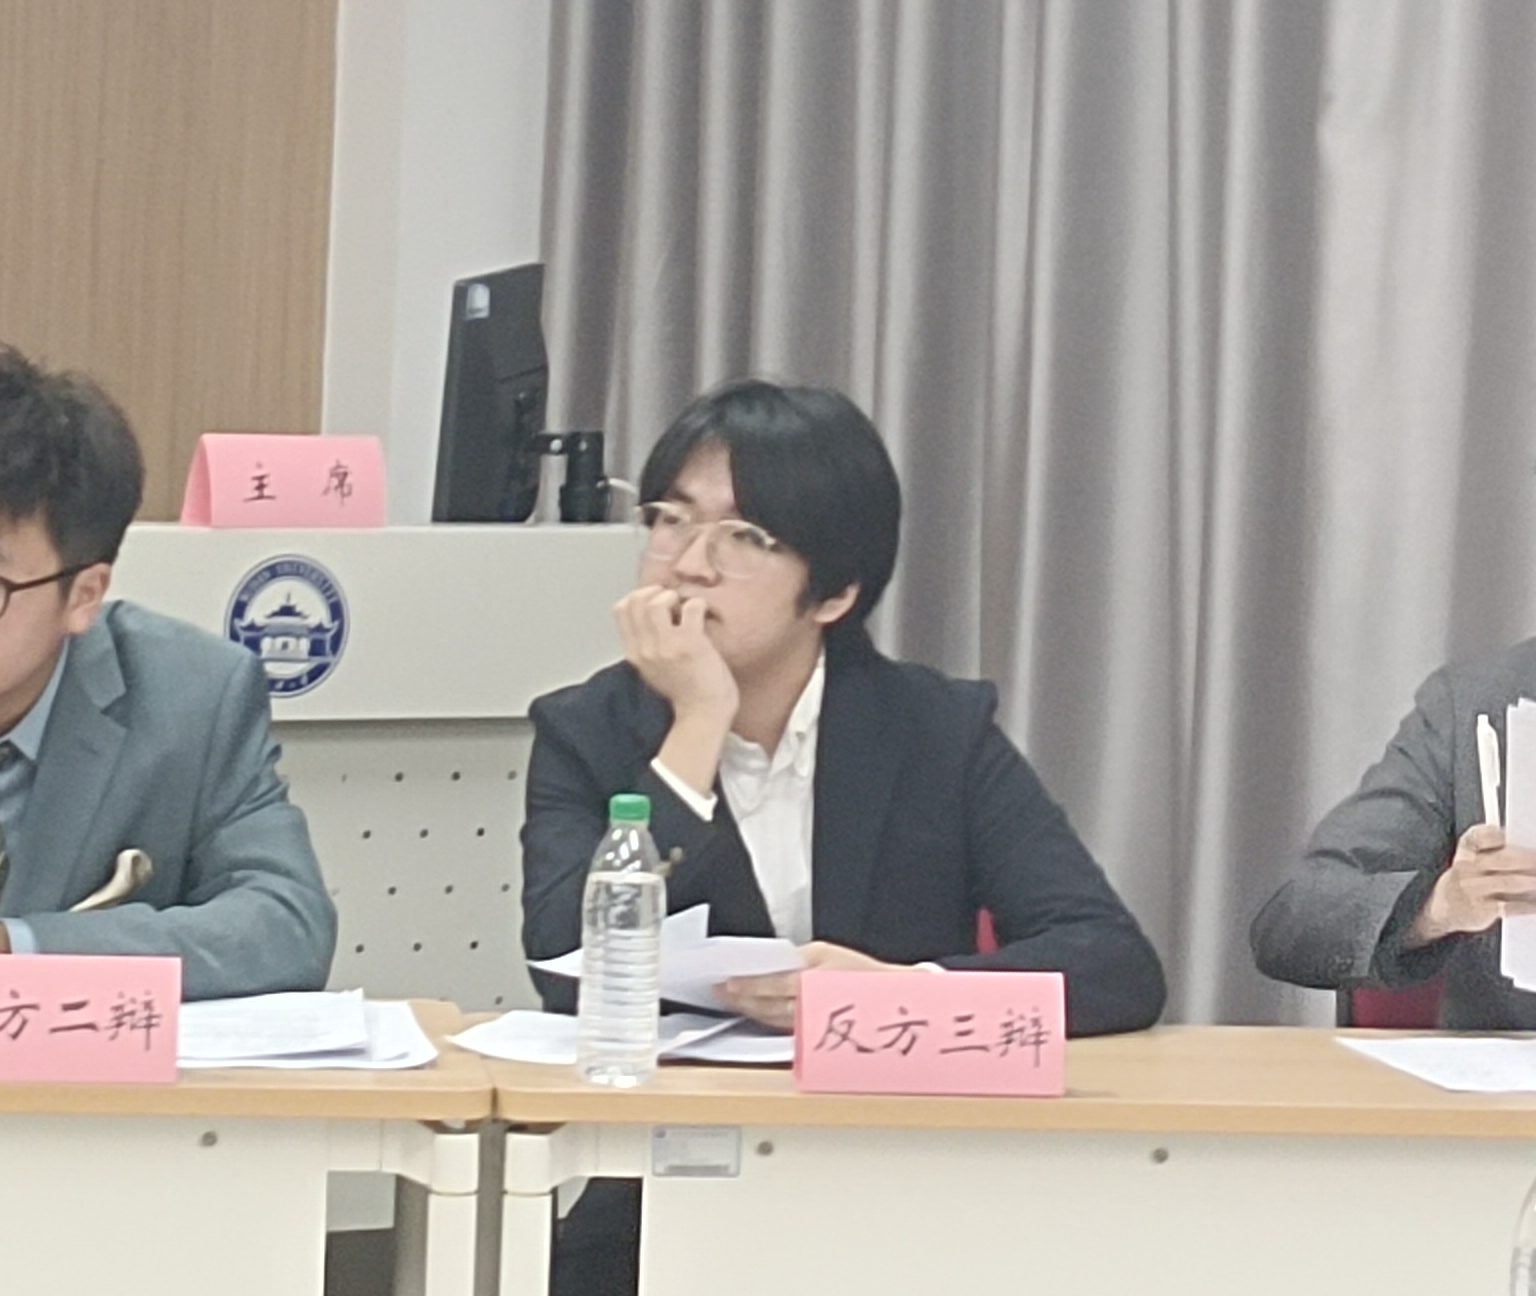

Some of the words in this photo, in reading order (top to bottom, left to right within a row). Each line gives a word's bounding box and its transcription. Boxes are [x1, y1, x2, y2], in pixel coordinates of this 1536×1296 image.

[242, 458, 354, 506] 主席
[812, 1002, 1053, 1068] 反方三辩
